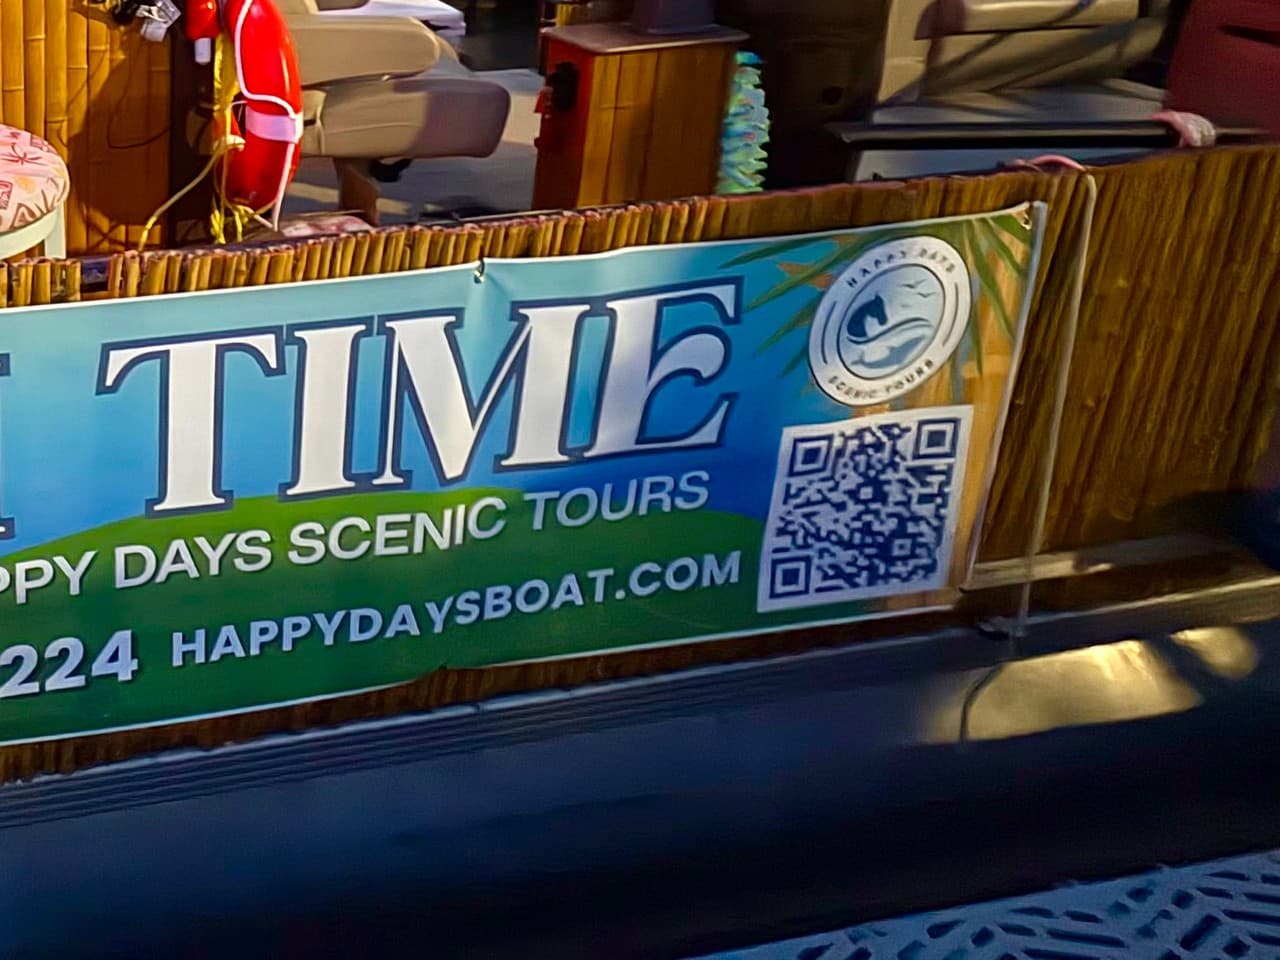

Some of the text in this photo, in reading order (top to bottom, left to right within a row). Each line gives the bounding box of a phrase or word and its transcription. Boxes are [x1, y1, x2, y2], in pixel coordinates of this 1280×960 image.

[95, 277, 743, 518] TIME
[114, 531, 273, 589] DAYS
[287, 497, 506, 564] SCENIC
[524, 471, 710, 532] TOURS
[172, 551, 742, 666] HAPPYDAYSBOAT.COM
